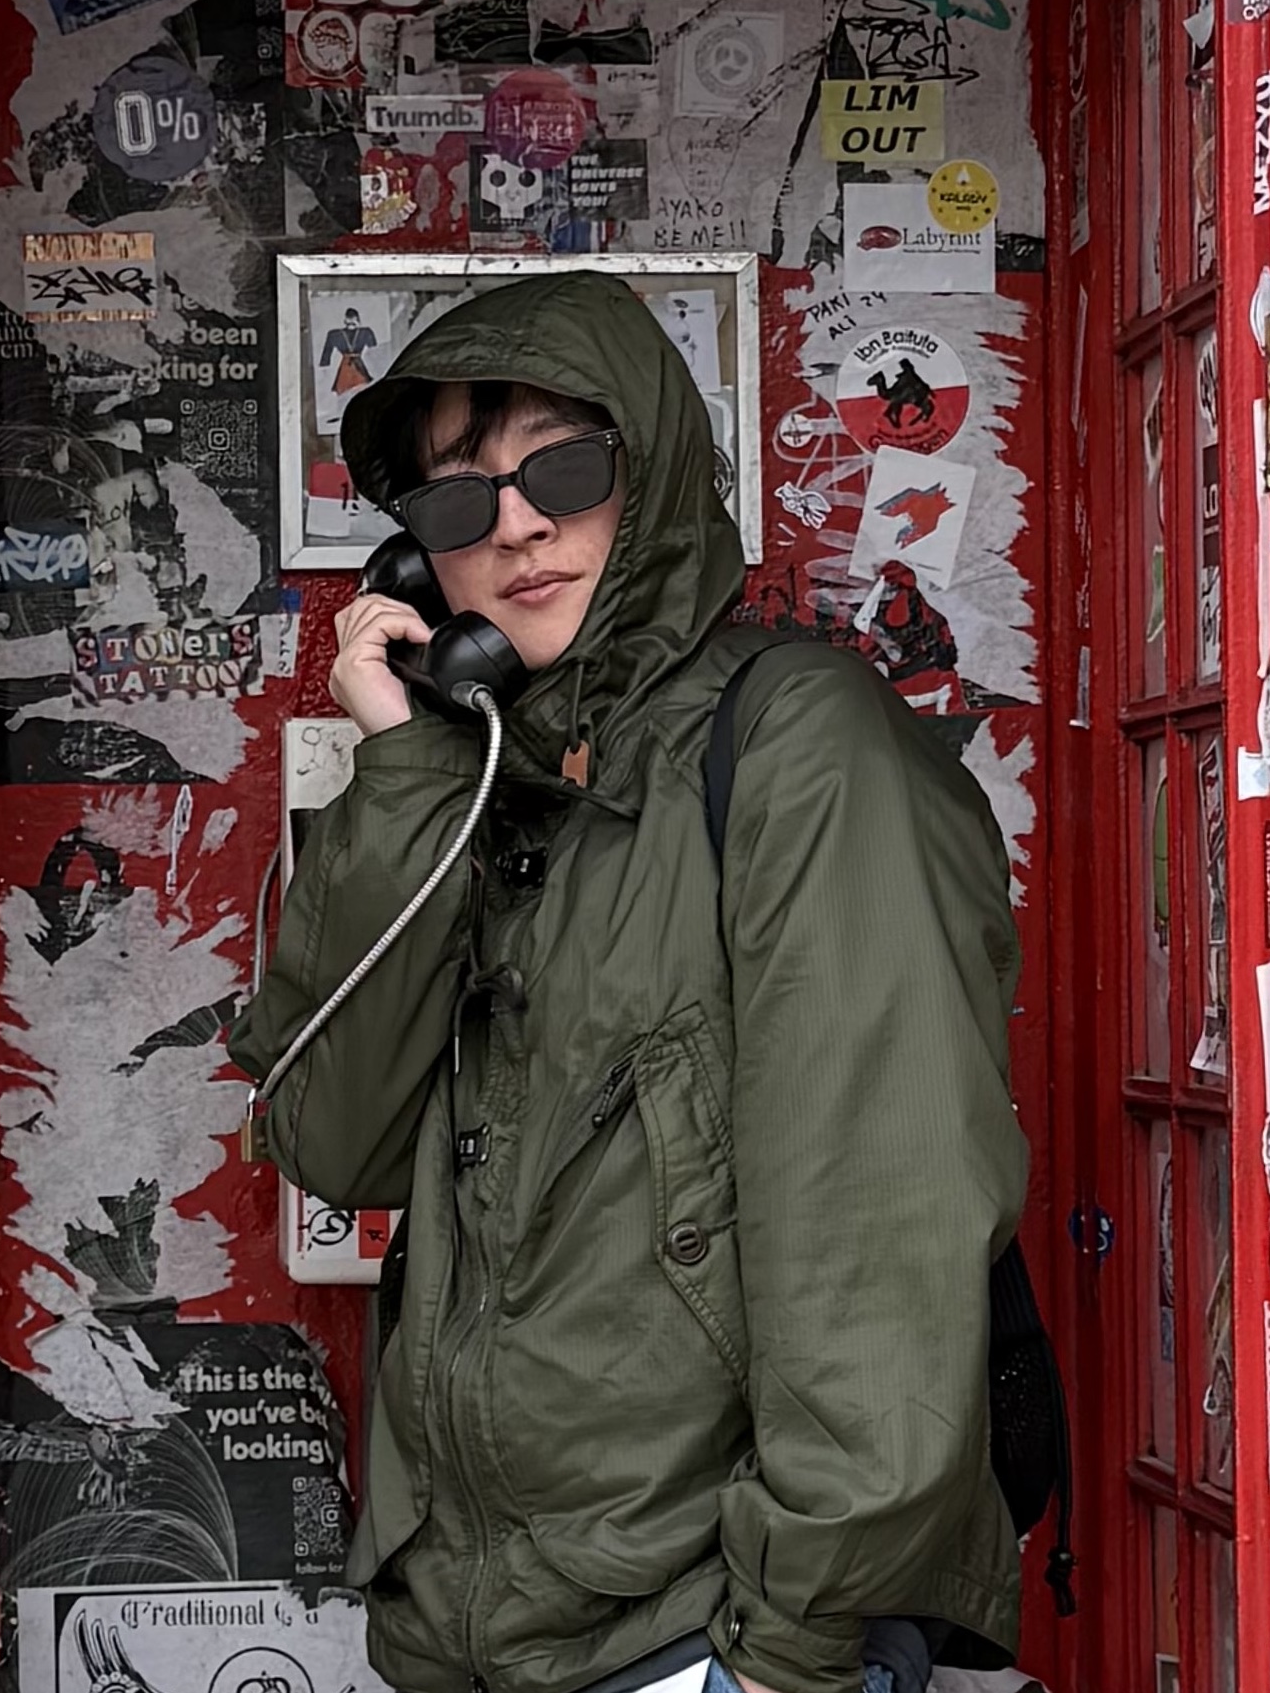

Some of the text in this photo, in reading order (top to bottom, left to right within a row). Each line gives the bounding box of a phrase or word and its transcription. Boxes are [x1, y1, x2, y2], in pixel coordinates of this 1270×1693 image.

[843, 84, 920, 113] LIM
[114, 89, 201, 157] 0%
[841, 126, 927, 154] OUT
[189, 319, 258, 346] been
[218, 353, 259, 381] for
[178, 1365, 307, 1394] This is the
[205, 1398, 296, 1434] you've
[223, 1435, 325, 1466] looking
